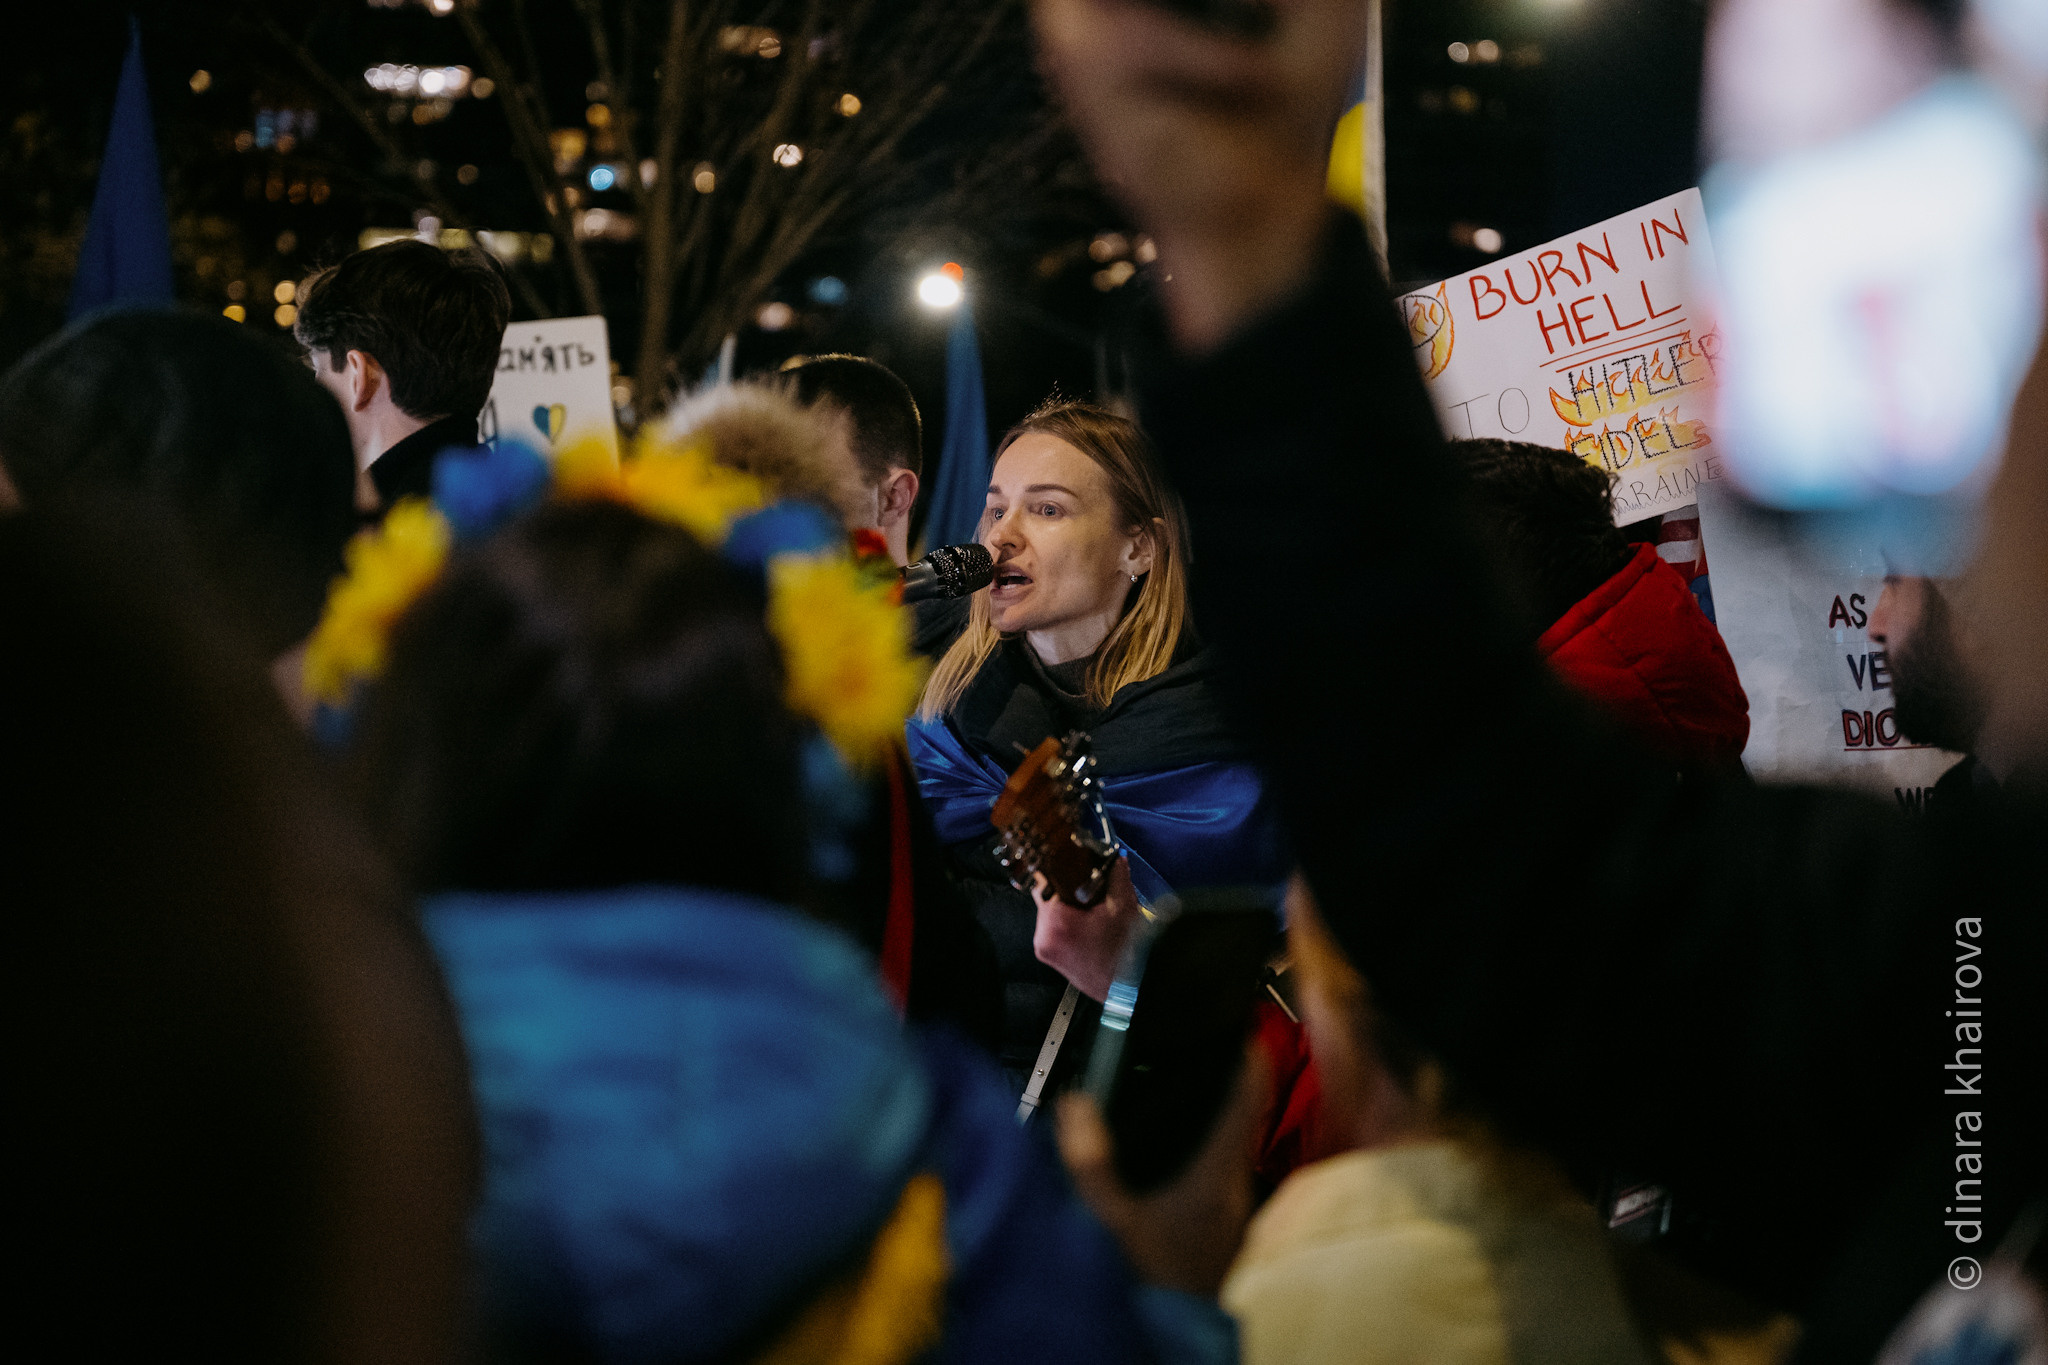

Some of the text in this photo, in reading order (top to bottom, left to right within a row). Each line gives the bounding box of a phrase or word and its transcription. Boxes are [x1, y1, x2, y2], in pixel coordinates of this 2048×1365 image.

[1468, 208, 1690, 321] BURN IN
[1536, 280, 1683, 354] HELL
[1448, 332, 1724, 440] TO HITLER
[1610, 455, 1724, 508] KRAINE
[1828, 593, 1868, 629] AS
[1846, 651, 1892, 692] VE
